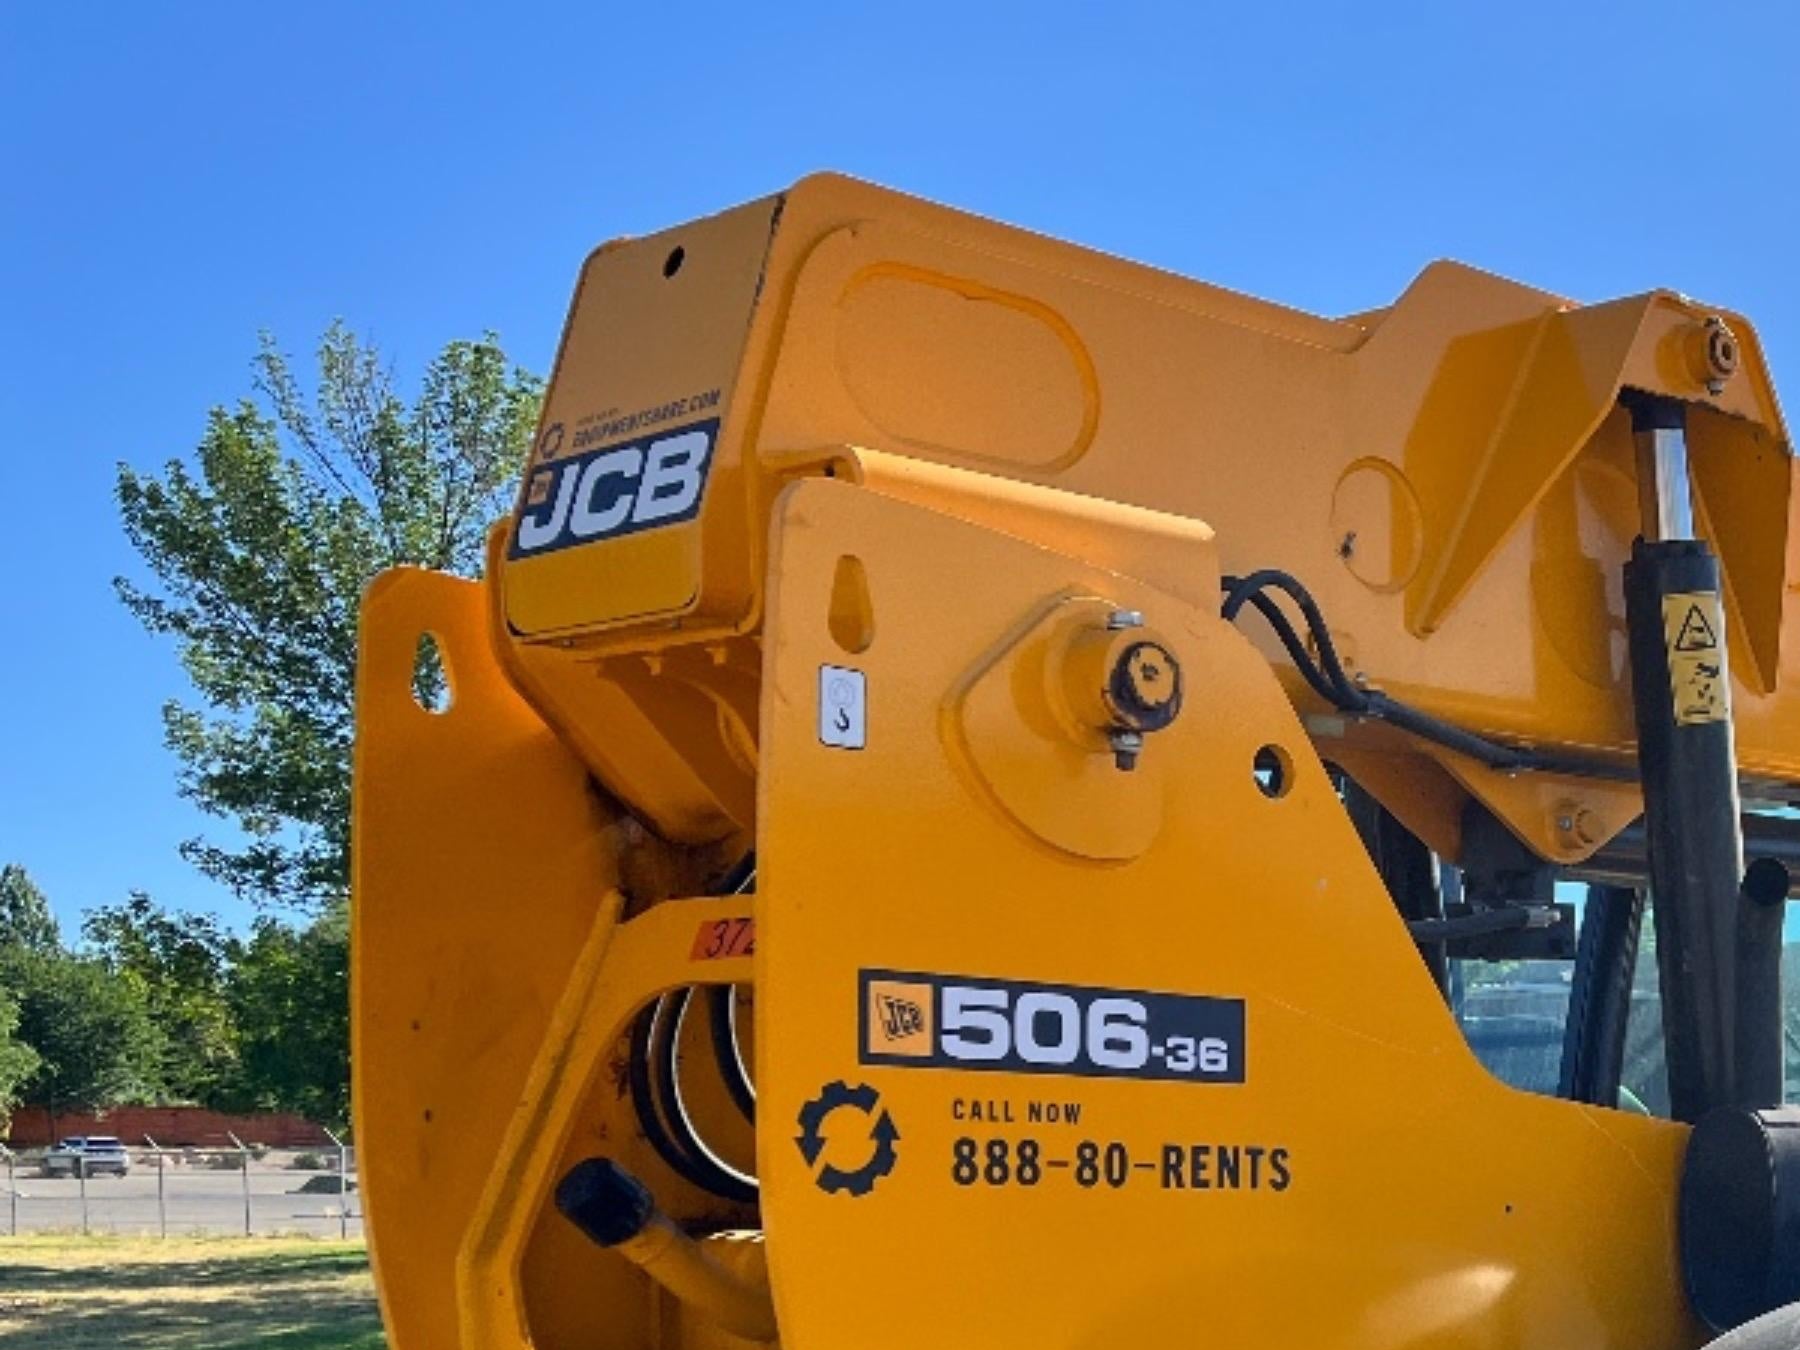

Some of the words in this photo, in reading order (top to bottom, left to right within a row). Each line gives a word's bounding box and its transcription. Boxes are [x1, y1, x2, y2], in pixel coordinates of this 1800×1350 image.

[517, 430, 709, 550] JCB
[940, 985, 1229, 1073] 506-36
[951, 1098, 1016, 1124] CALL
[1026, 1101, 1082, 1126] NOW
[951, 1136, 1292, 1192] 888-80-RENTS
